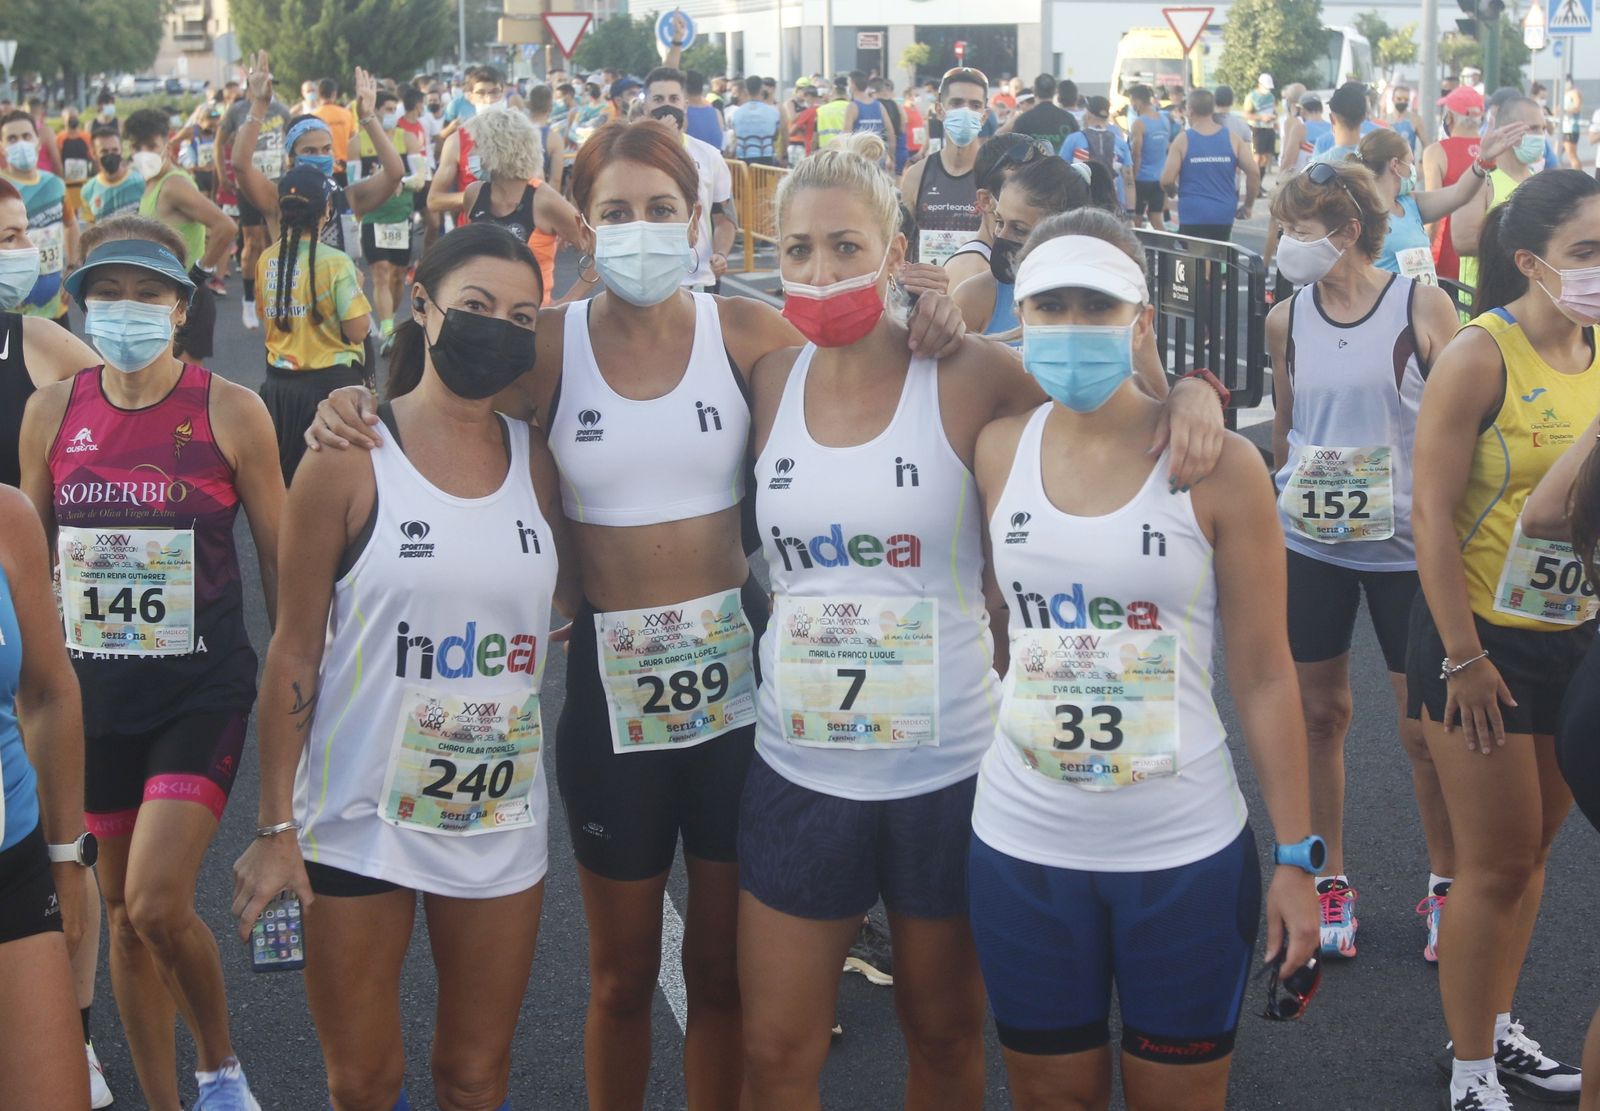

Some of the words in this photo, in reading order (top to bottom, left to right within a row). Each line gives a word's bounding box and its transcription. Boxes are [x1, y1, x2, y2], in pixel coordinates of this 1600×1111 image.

[59, 481, 187, 507] SOBERBIO
[1302, 490, 1370, 519] 152
[100, 508, 121, 518] Oliva
[122, 508, 150, 519] Virgen
[151, 508, 176, 518] Extra
[96, 534, 131, 545] XXXV
[771, 524, 921, 572] indea
[80, 571, 105, 579] CARMEN
[107, 572, 127, 580] REINA
[83, 587, 166, 624] 146
[823, 604, 862, 617] XXXV
[1012, 581, 1162, 630] indea
[643, 610, 683, 628] XXXV
[1058, 635, 1101, 650] XXXV
[396, 621, 537, 680] indea
[838, 650, 867, 658] FRANCO
[870, 650, 895, 659] LUQUE
[639, 658, 664, 668] LAURA
[637, 662, 729, 714] 289
[837, 668, 866, 711] 7
[1053, 685, 1068, 693] EVA
[1070, 686, 1082, 694] GIL
[1085, 686, 1124, 695] CABEZAS
[462, 702, 501, 717] XXXV
[827, 722, 881, 732] serizona
[1053, 704, 1124, 751] 33
[438, 742, 465, 753] CHARO
[466, 747, 485, 755] ALBA
[485, 744, 515, 754] MORALES
[422, 758, 514, 802] 240
[145, 781, 201, 796] ORCHA
